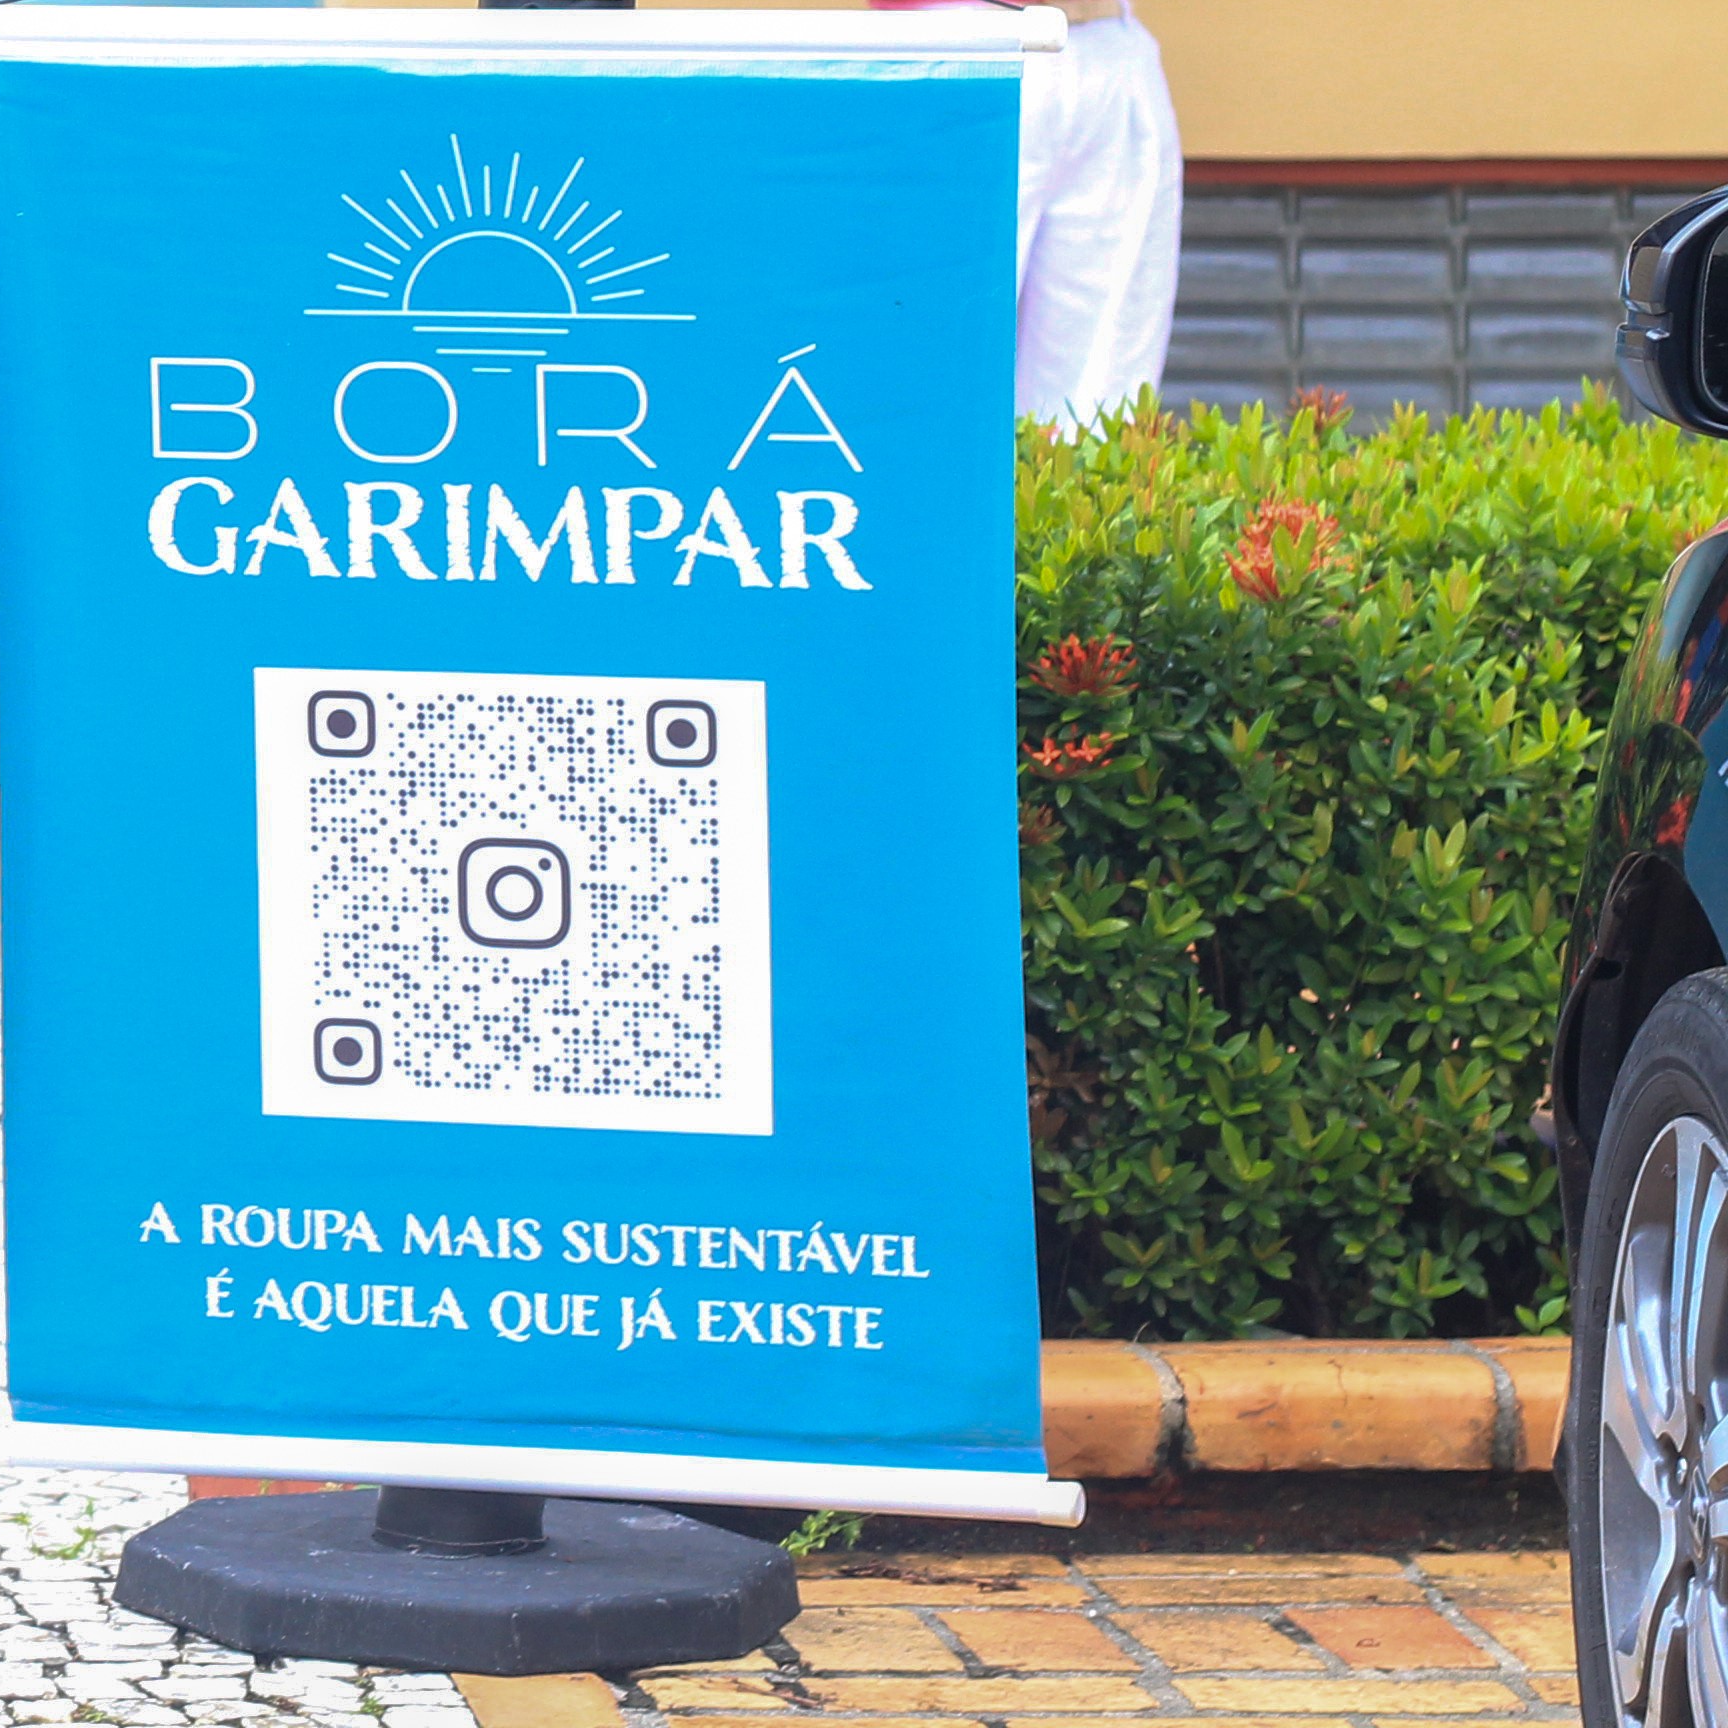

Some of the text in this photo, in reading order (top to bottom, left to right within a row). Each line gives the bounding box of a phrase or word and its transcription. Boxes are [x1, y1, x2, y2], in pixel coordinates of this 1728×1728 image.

[149, 343, 864, 473] BORÁ
[147, 475, 874, 590] GARIMPAR
[139, 1201, 930, 1279] A ROUPA MAIS SUSTENTÁVEL
[205, 1267, 885, 1351] É AQUELA QUE JÁ EXISTE
